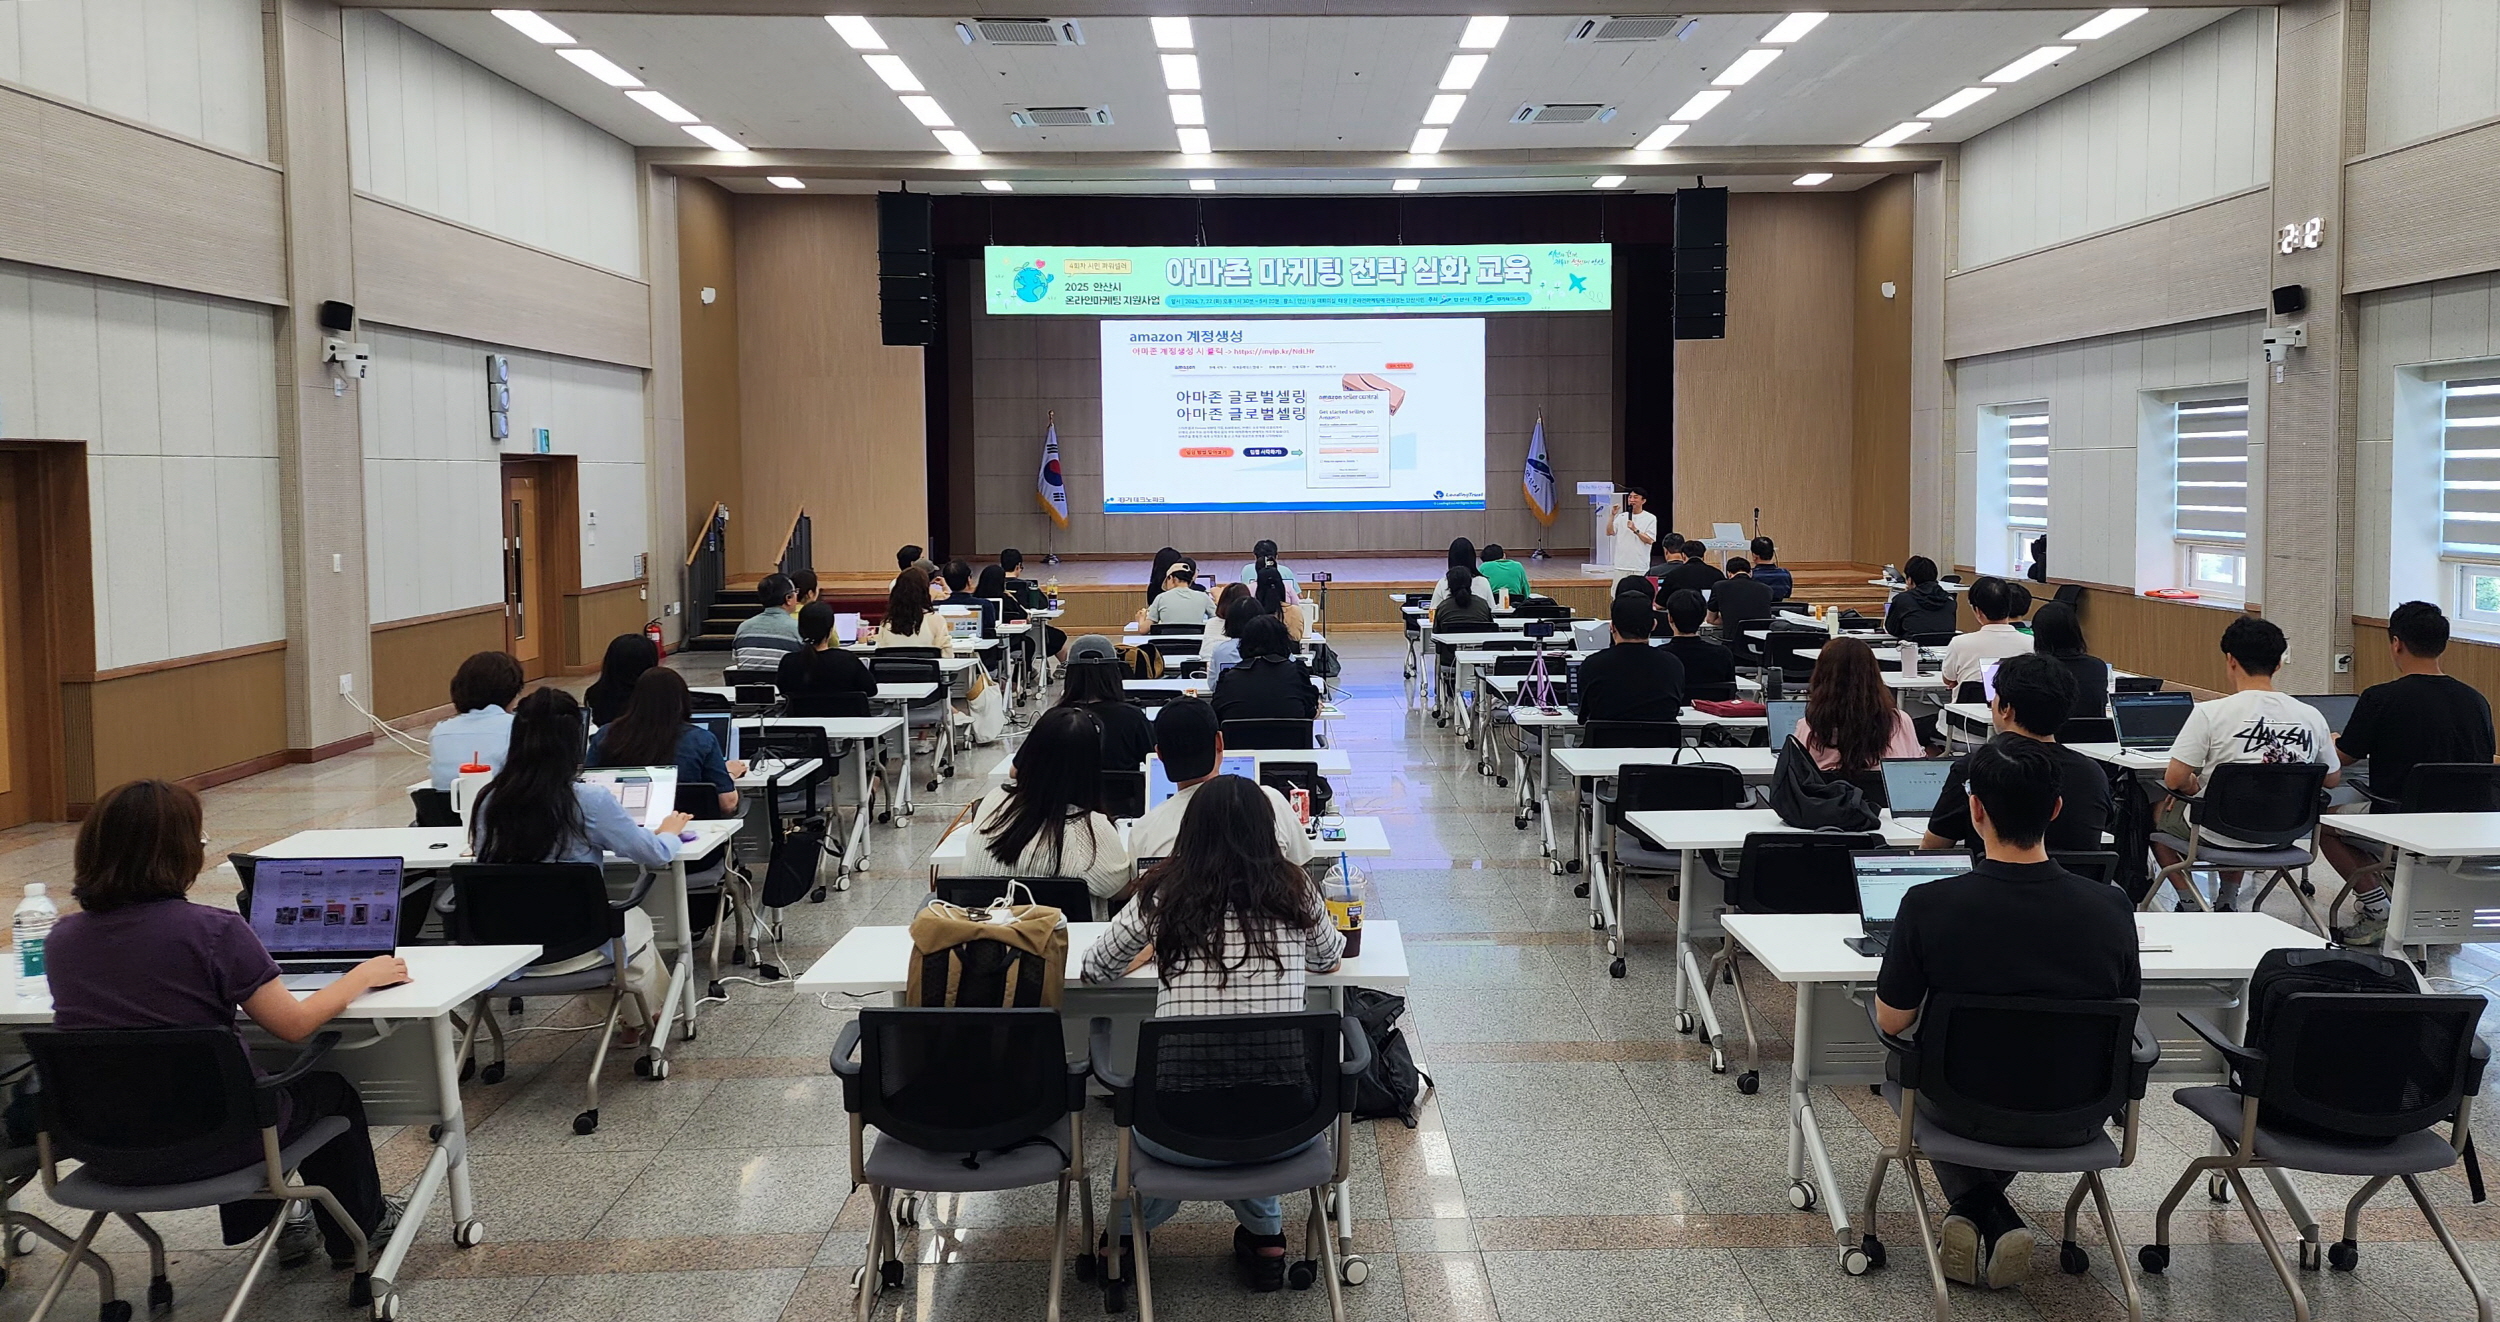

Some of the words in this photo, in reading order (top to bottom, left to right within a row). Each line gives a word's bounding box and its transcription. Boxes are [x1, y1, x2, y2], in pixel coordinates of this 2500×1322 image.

[1165, 257, 1252, 287] 아마존
[1258, 257, 1345, 287] 마케팅
[1349, 256, 1408, 287] 전략
[1412, 255, 1471, 286] 심화
[1475, 254, 1532, 285] 교육
[1065, 282, 1089, 292] 2025
[1093, 282, 1122, 292] 안산시
[1065, 295, 1122, 306] 온라인마케팅
[1123, 295, 1160, 306] 지원사업
[1129, 333, 1183, 342] amazon
[1187, 330, 1243, 343] 계정생성
[1132, 347, 1158, 356] 아마존
[1160, 347, 1194, 356] 계정생성
[1196, 347, 1204, 356] 시
[1176, 390, 1223, 404] 아마존
[1228, 389, 1306, 404] 글로벌셀링
[1176, 407, 1223, 421] 아마존
[1228, 407, 1306, 421] 글로벌셀링
